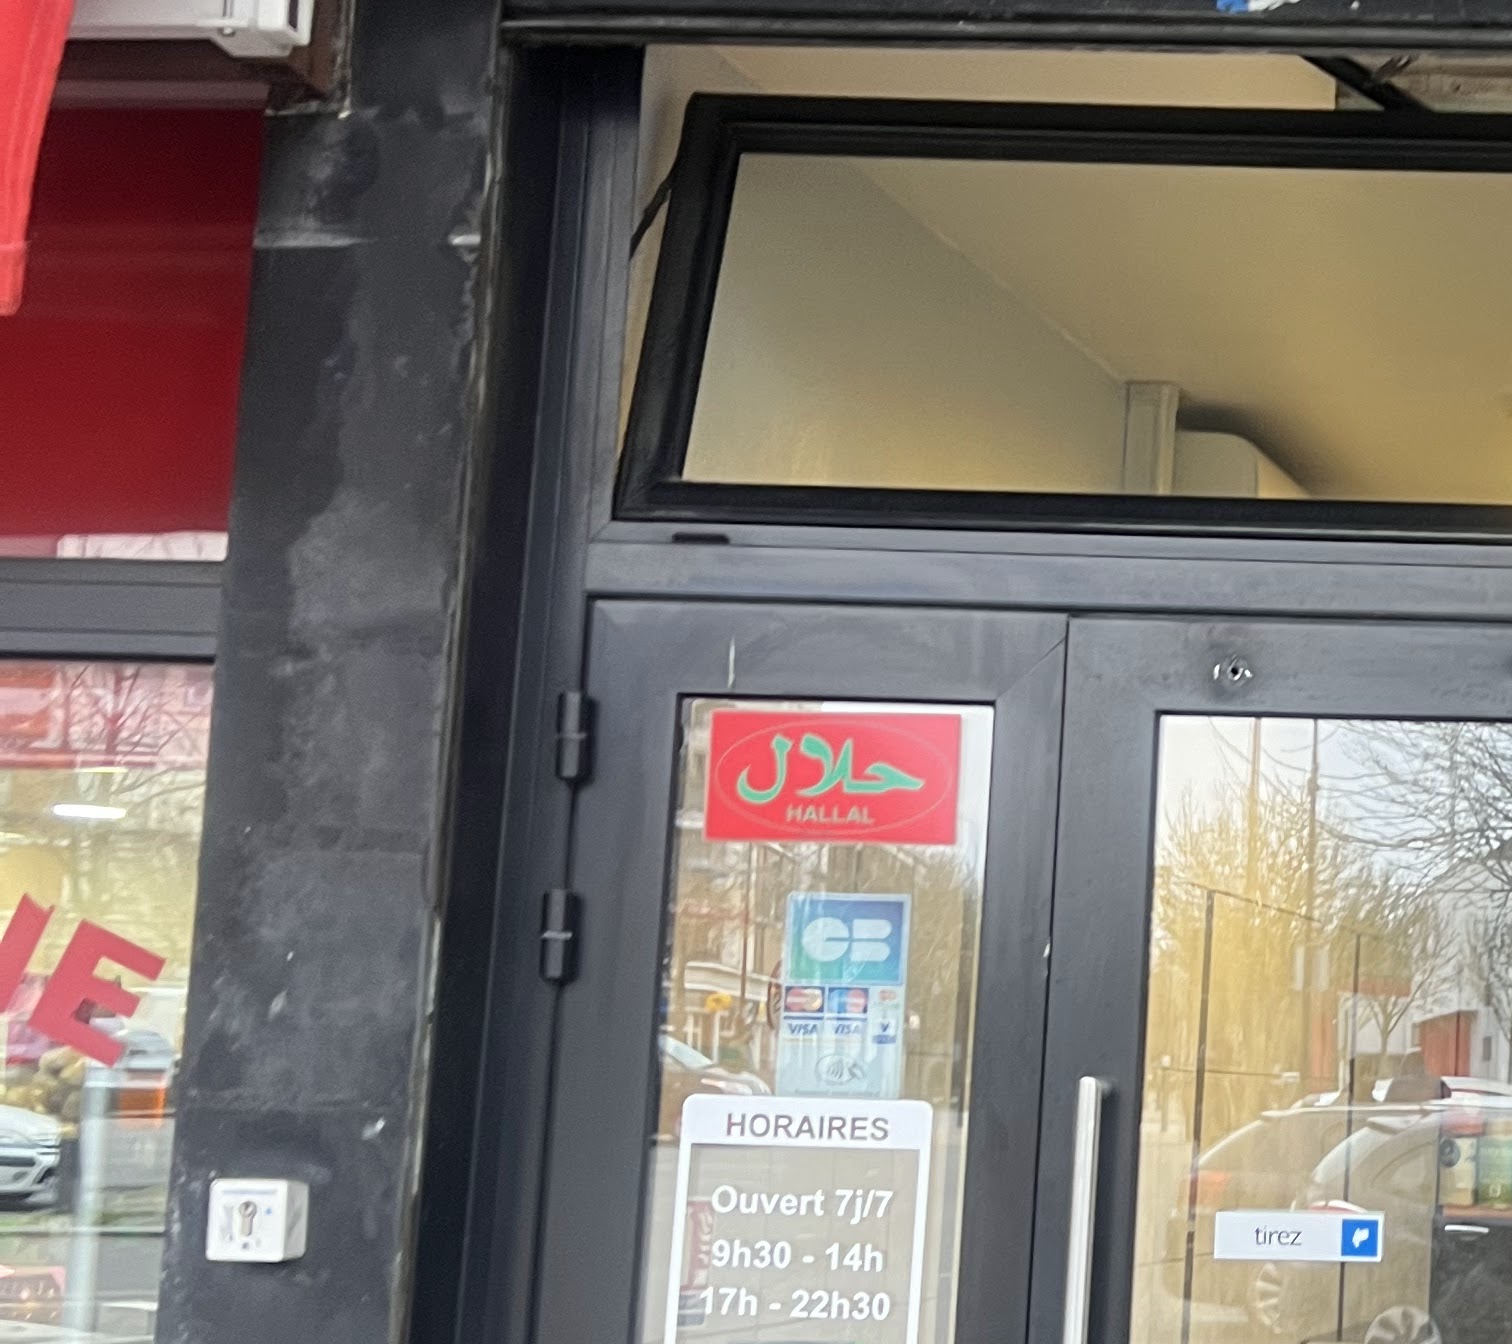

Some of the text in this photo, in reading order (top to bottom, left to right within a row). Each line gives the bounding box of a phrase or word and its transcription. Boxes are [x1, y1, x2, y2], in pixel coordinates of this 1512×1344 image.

[735, 732, 926, 805] حلال
[785, 803, 876, 824] HALLAL
[787, 1023, 818, 1035] VISA
[727, 1113, 890, 1142] HORAIRES
[710, 1186, 894, 1224] Ouvert 7j/7
[1254, 1225, 1303, 1248] tirez
[711, 1239, 791, 1270] 9h30
[825, 1243, 885, 1273] 14h
[701, 1288, 758, 1317] 17h
[790, 1289, 891, 1322] 22h30
